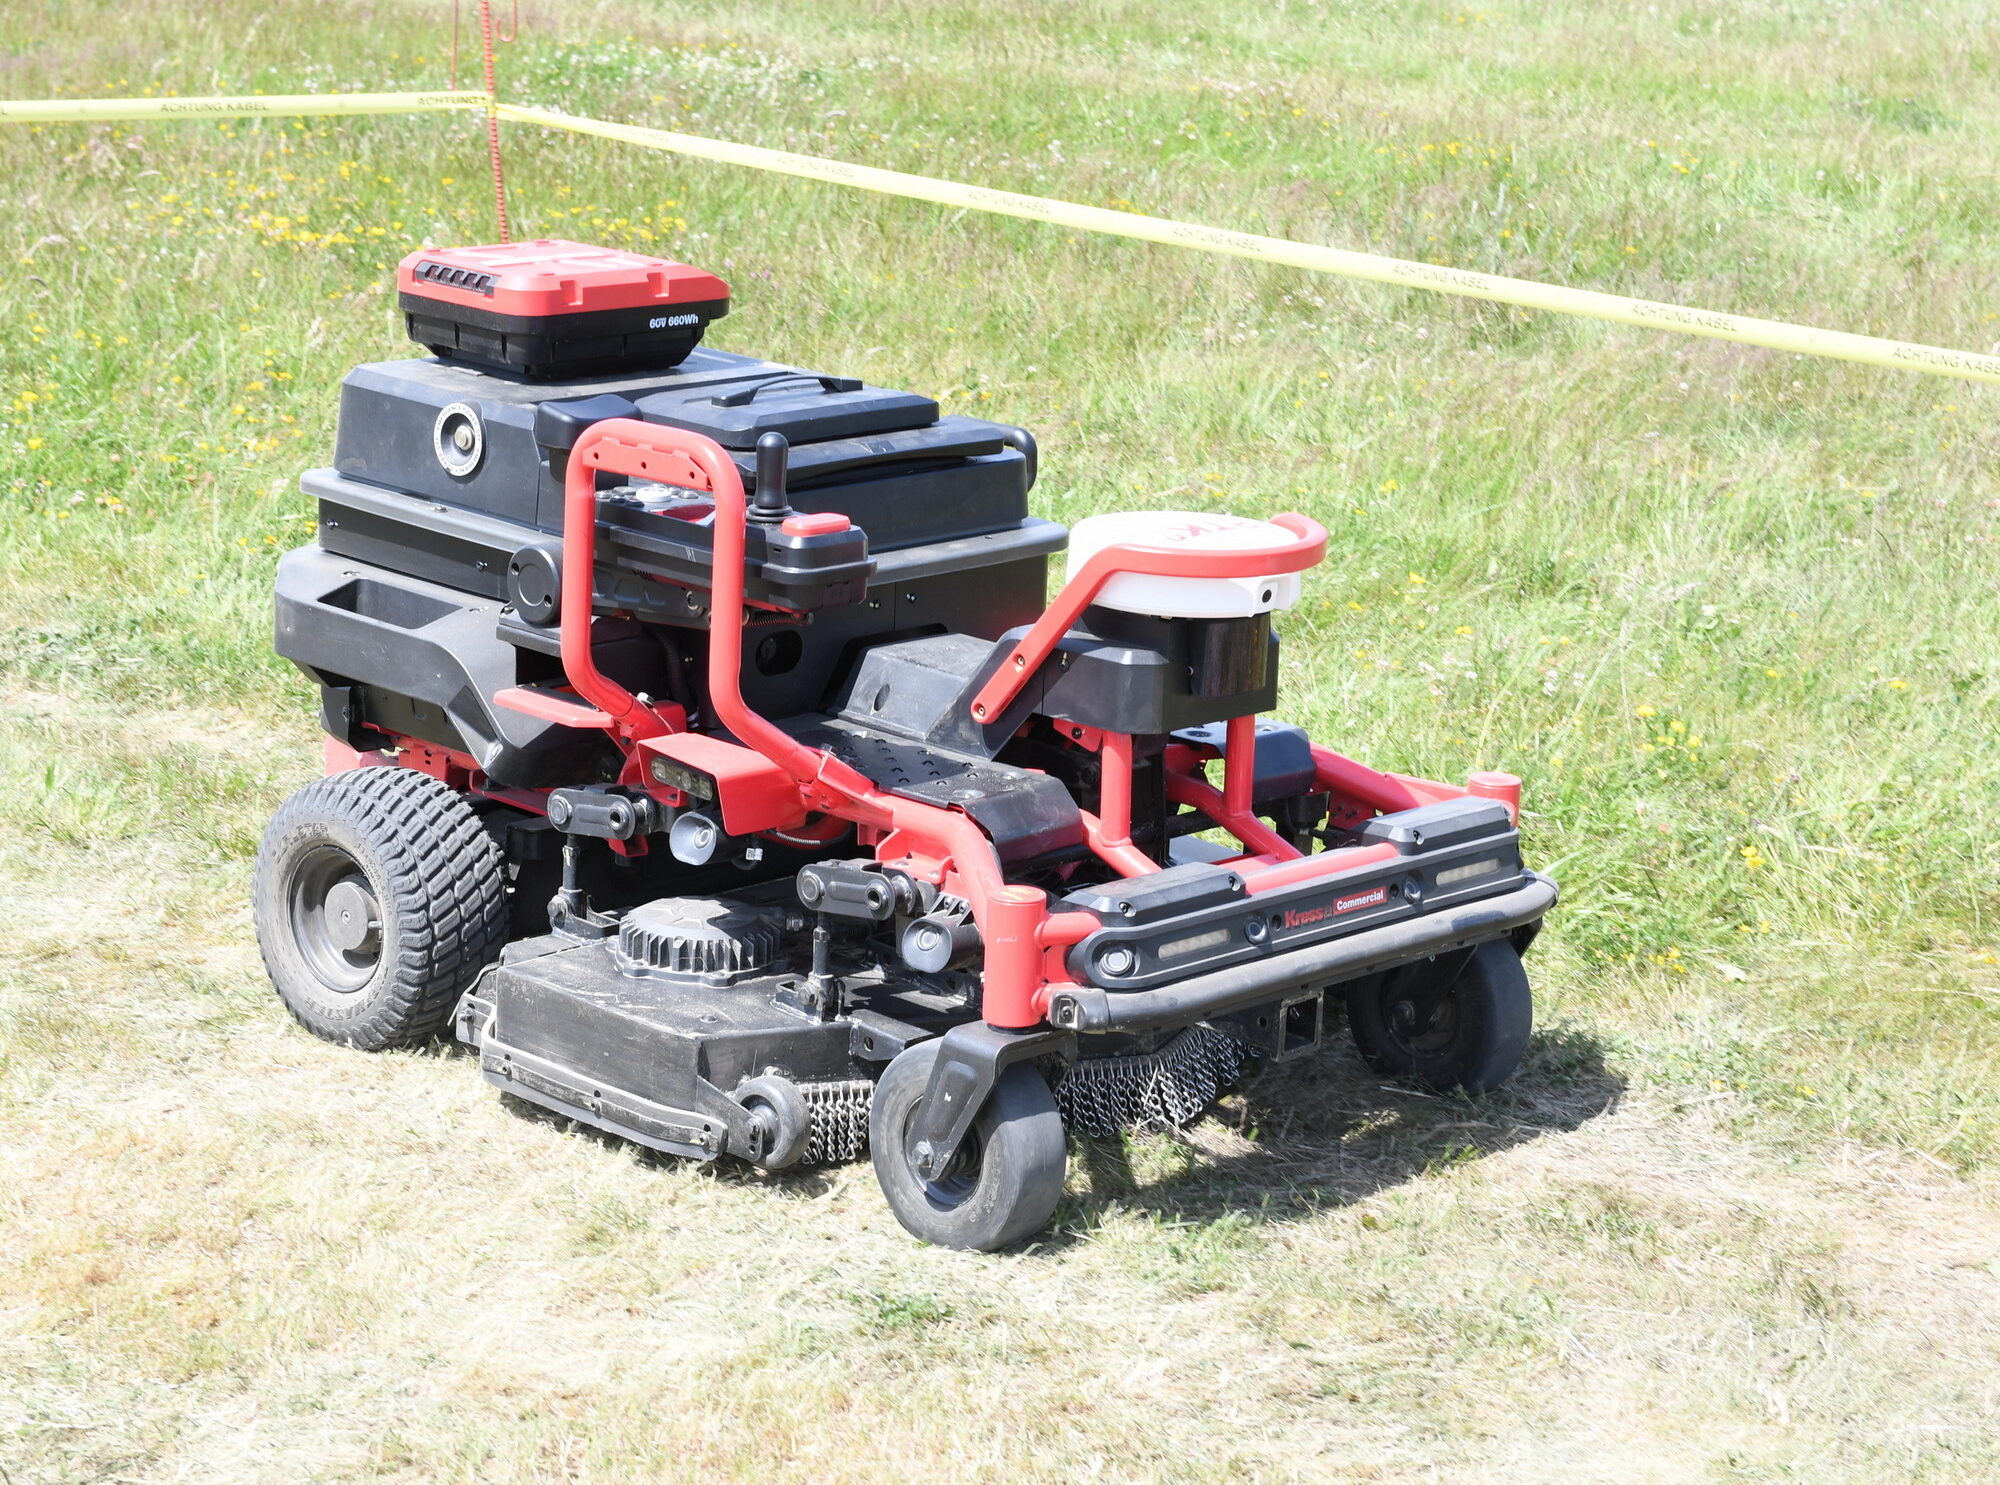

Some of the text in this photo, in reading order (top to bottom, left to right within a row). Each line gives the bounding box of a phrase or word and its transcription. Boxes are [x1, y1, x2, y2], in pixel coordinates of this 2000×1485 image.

[160, 101, 270, 114] ACHTUNG KABEL
[417, 95, 479, 107] ACHTUNG
[1227, 236, 1262, 253] KABEL
[1392, 263, 1491, 292] ACHTUNG KABEL
[649, 314, 699, 329] 60V 660Wh
[1631, 303, 1738, 333] ACHTUNG KABEL
[1892, 346, 1960, 370] ACHTUNG
[1283, 889, 1384, 929] Kress Commercial
